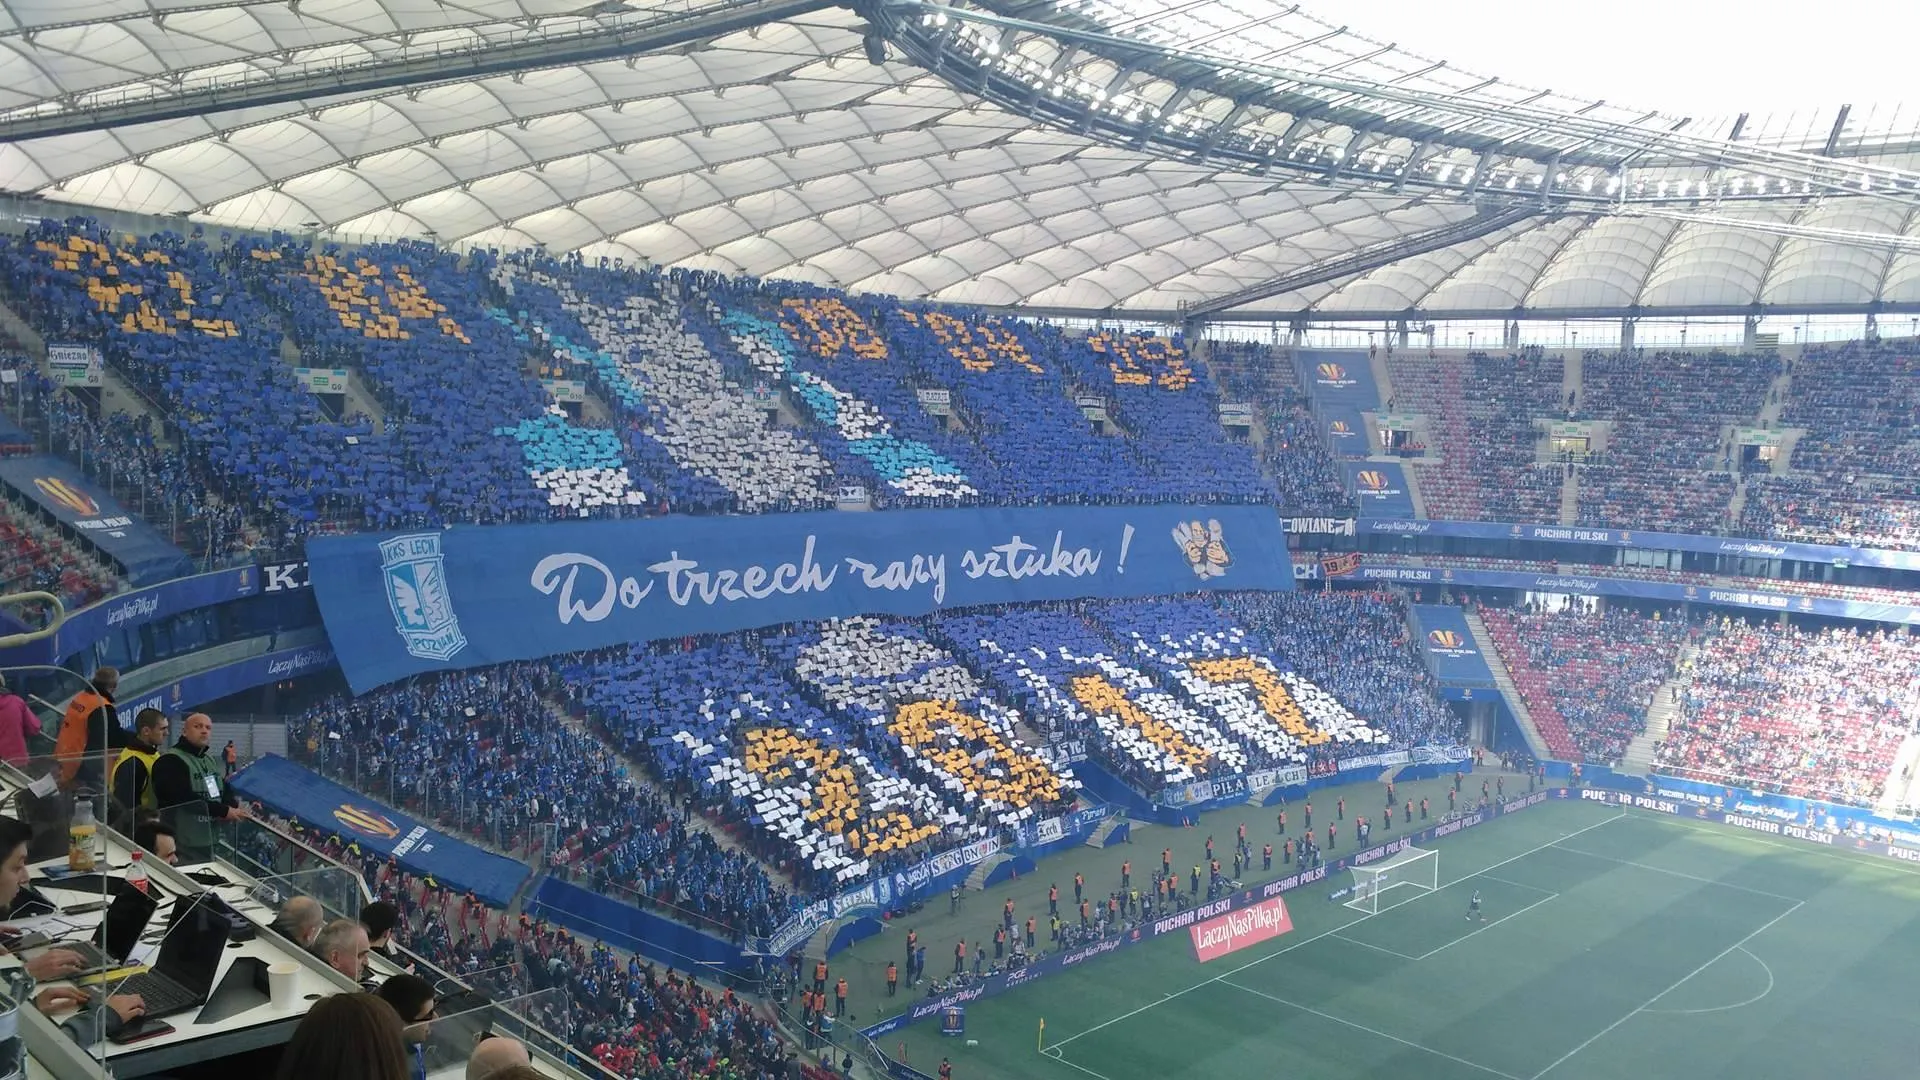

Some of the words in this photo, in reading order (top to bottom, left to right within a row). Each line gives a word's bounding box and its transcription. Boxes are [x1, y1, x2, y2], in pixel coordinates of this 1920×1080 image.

[1534, 528, 1571, 539] PUCHAR
[1574, 531, 1608, 541] POLSKI
[387, 543, 405, 561] KKS
[410, 539, 435, 555] LECH
[531, 552, 654, 624] Do
[646, 535, 838, 606] trzech
[845, 553, 945, 605] razy
[961, 529, 1102, 580] sztuka
[1364, 568, 1398, 579] PUCHAR
[1400, 569, 1432, 580] POLSKI
[1710, 590, 1749, 603] PUCHAR
[1751, 594, 1789, 607] POLSKI
[1503, 799, 1526, 814] PUCHAR
[1528, 791, 1547, 806] POLSKI
[1582, 789, 1632, 806] PUCR
[1636, 797, 1678, 814] POLSKI
[1435, 820, 1460, 837] PUCHAR
[1725, 813, 1779, 834] PUCHAR
[1784, 826, 1833, 845] POLSKI
[1355, 844, 1385, 865] PUCHAR
[1386, 837, 1411, 854] POLSKI
[1264, 875, 1298, 897] PUCHAR
[1154, 911, 1195, 935] PUCHAR
[1197, 898, 1231, 921] POLSKI
